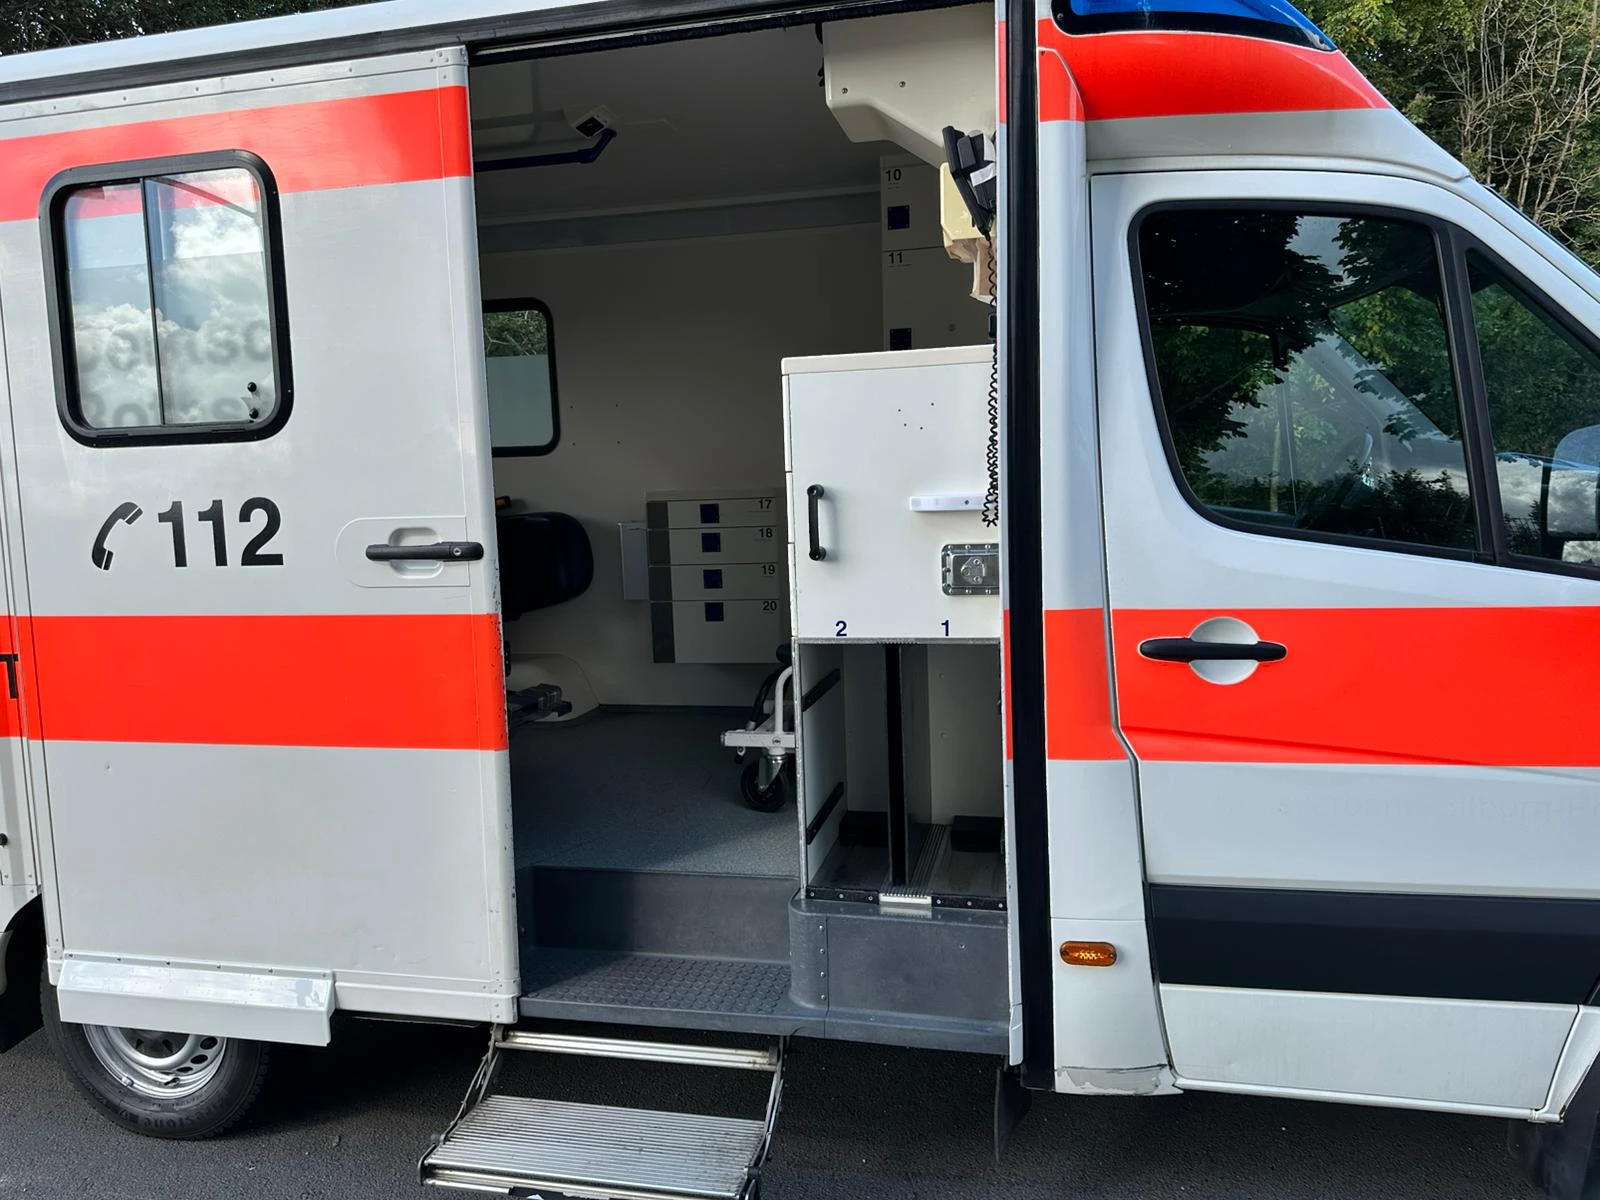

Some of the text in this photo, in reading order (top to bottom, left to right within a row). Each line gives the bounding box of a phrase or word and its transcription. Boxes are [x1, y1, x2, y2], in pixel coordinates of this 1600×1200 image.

[886, 168, 902, 181] 10
[889, 252, 903, 264] 11
[758, 499, 772, 509] 17
[157, 496, 284, 567] 112
[759, 528, 773, 538] 18
[761, 565, 775, 575] 19
[763, 601, 777, 611] 20
[835, 620, 847, 636] 2
[941, 619, 950, 636] 1
